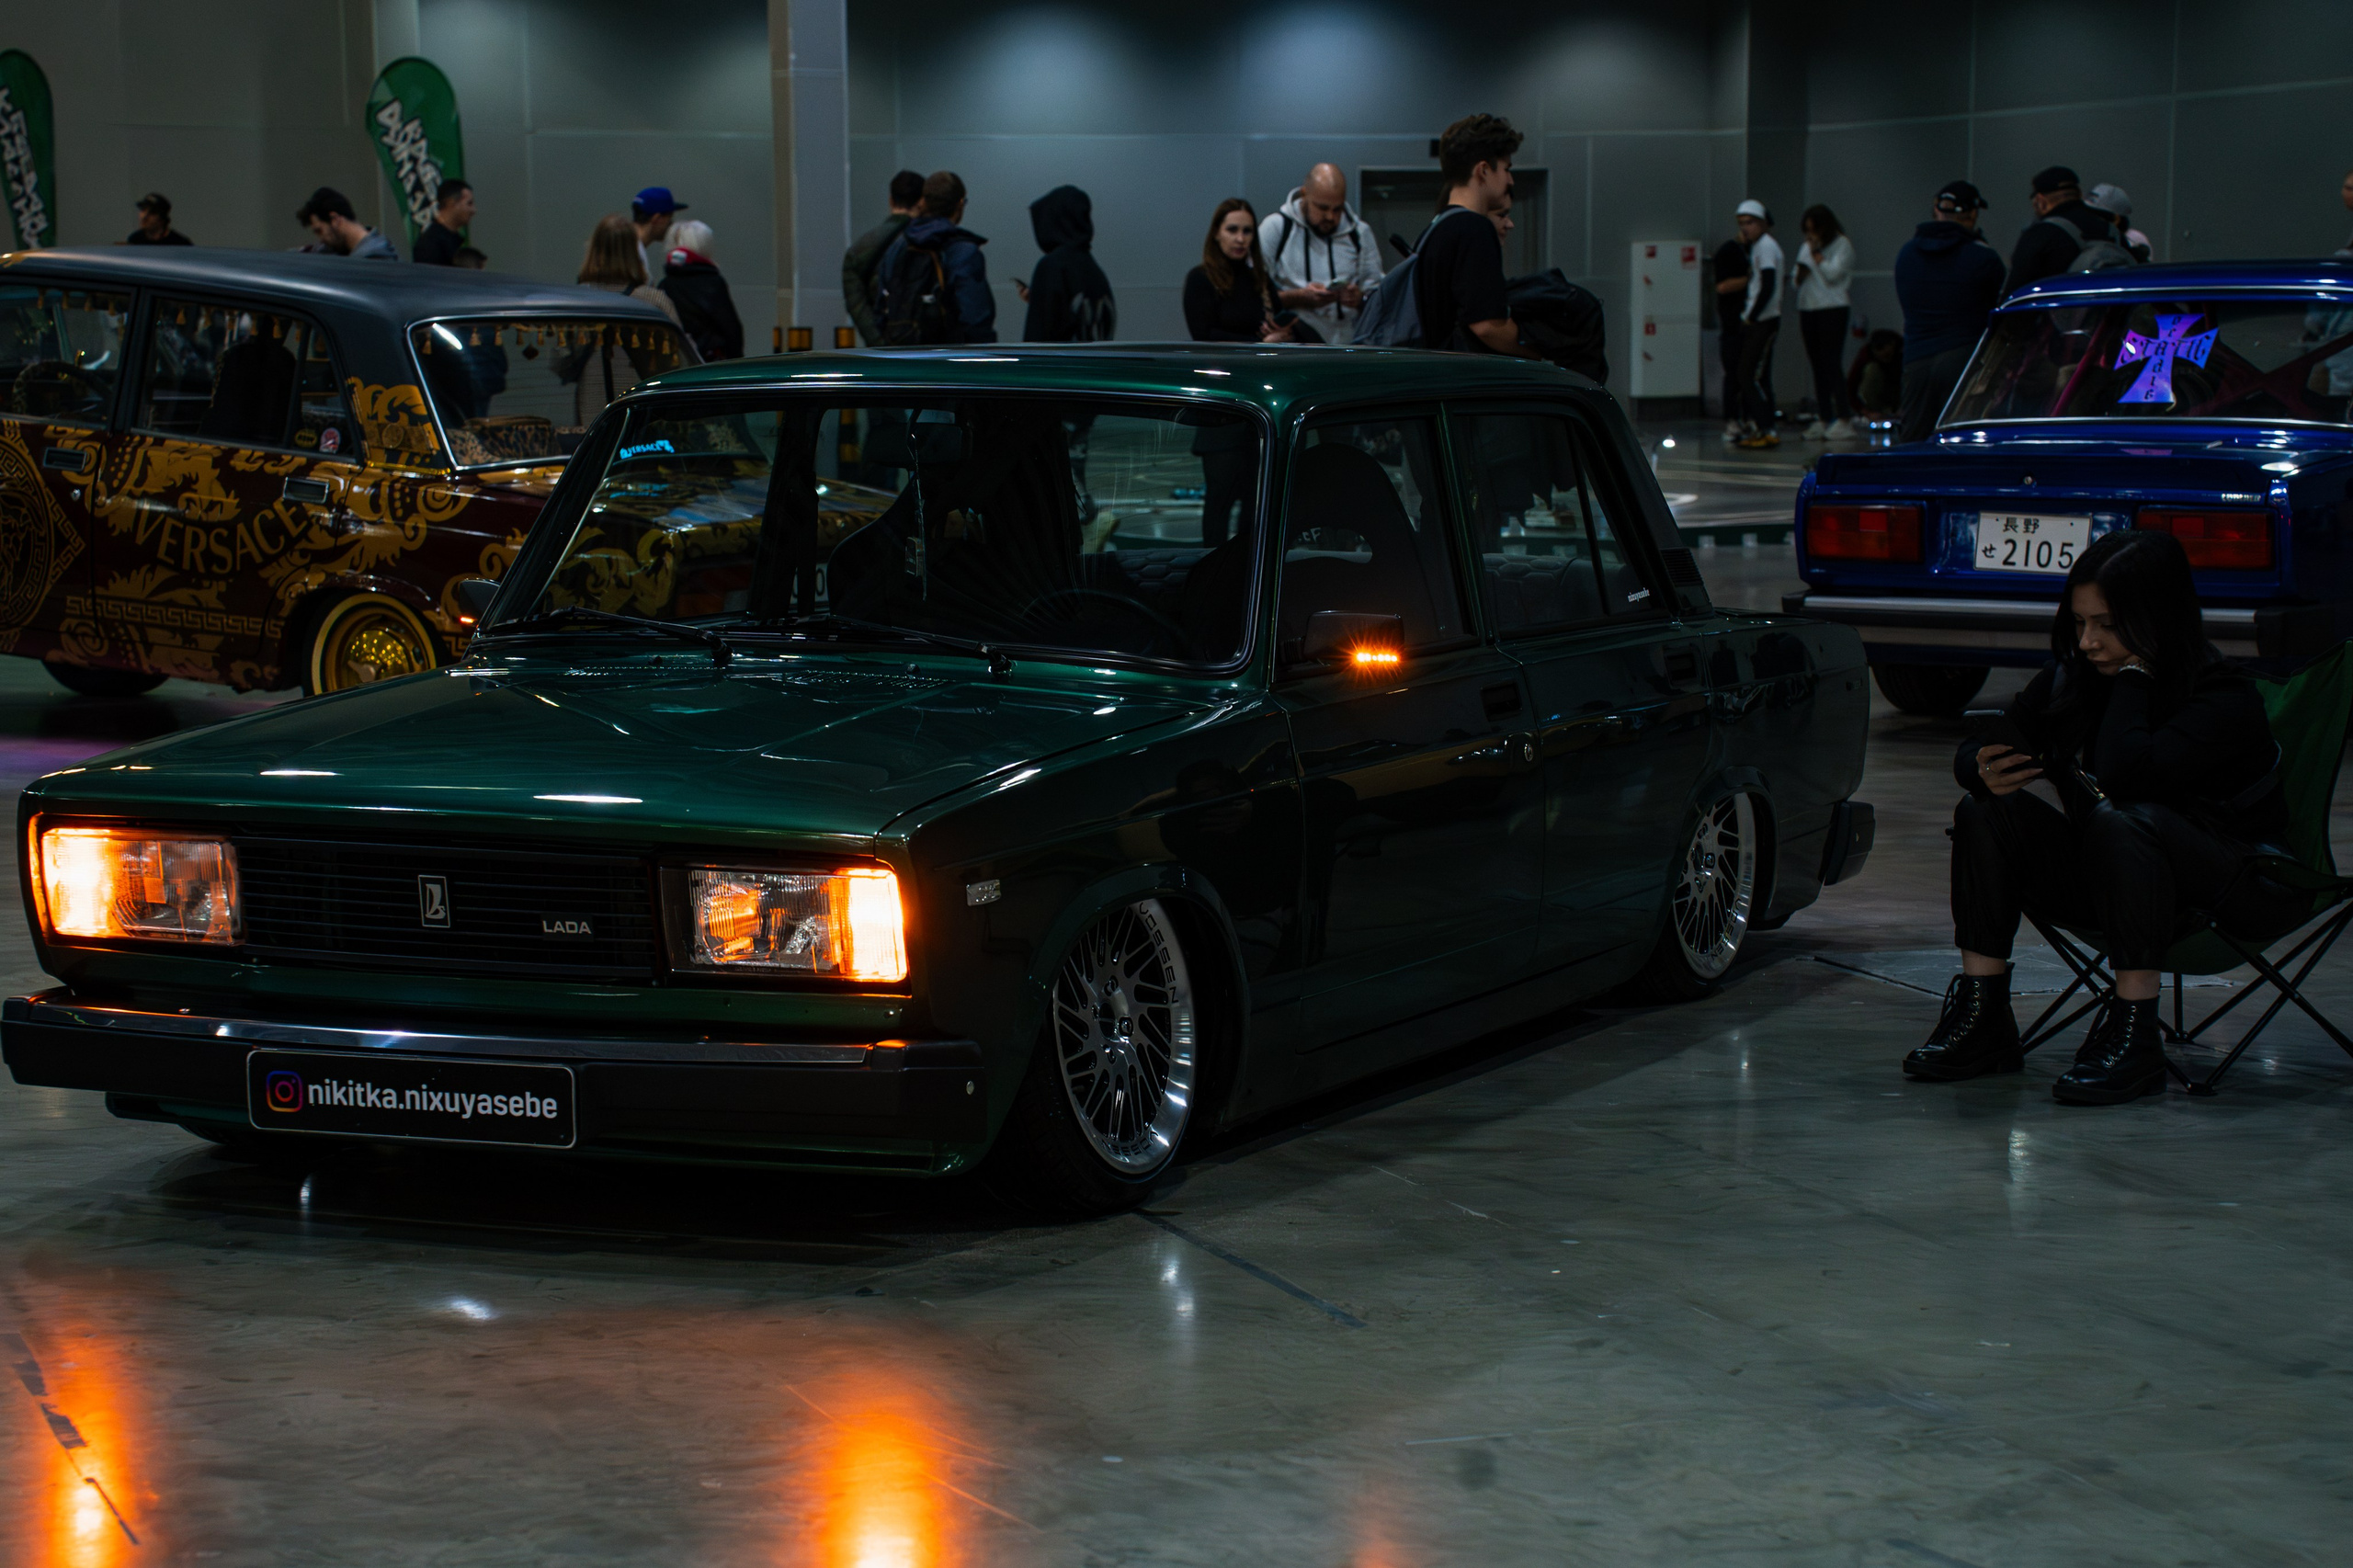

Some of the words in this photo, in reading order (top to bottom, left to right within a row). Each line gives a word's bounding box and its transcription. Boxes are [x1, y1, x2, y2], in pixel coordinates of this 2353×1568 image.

[135, 496, 309, 575] VERSACE
[2003, 517, 2040, 534] 長野
[1982, 543, 1996, 559] せ
[2002, 539, 2074, 569] 2105
[542, 920, 592, 935] LADA
[308, 1078, 558, 1119] nikitka.nixuyasebe
